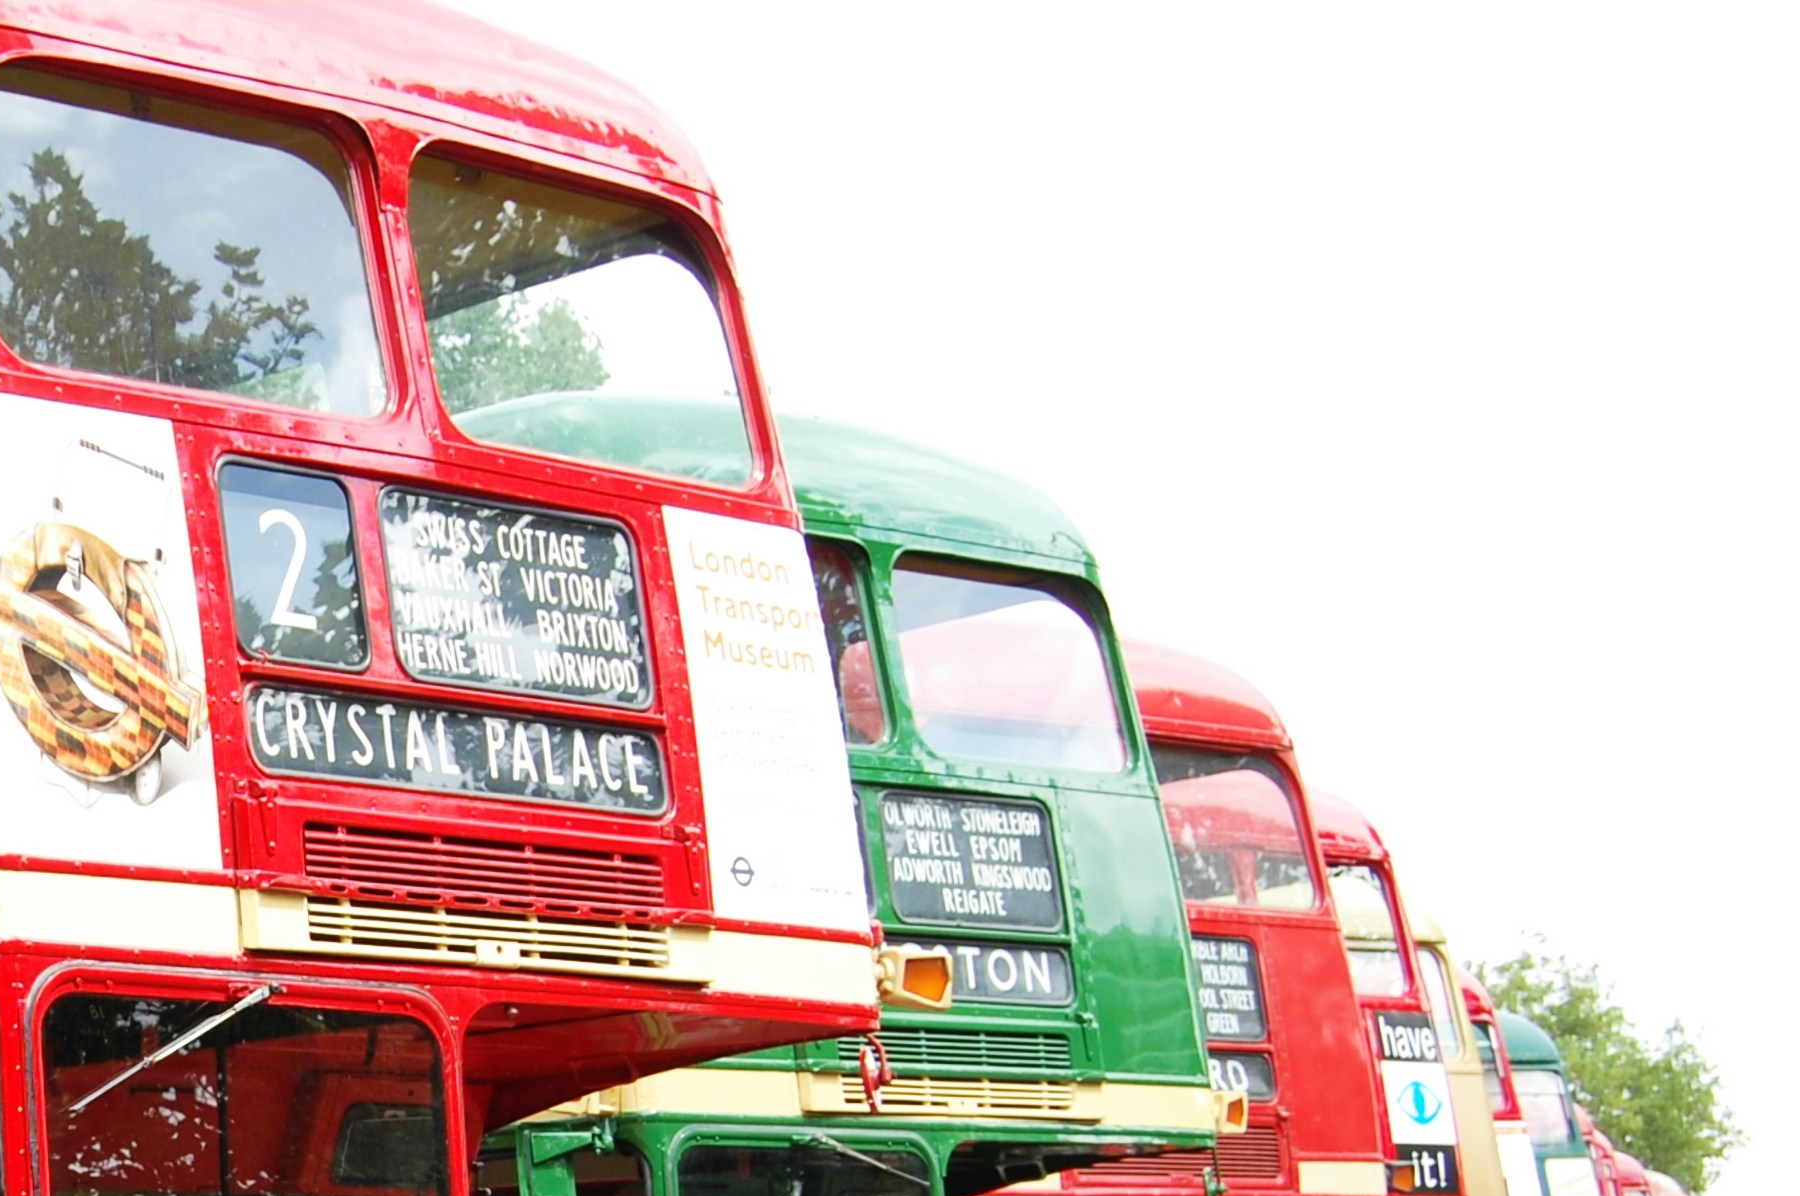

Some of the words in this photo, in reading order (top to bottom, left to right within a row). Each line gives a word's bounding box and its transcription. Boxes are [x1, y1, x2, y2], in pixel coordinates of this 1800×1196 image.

[412, 512, 485, 555] SWISS
[497, 525, 590, 570] COTTAGE
[688, 541, 789, 585] London
[258, 508, 317, 631] 2
[391, 549, 470, 593] BAKER
[477, 561, 502, 597] ST
[520, 567, 619, 615] VICTORIA
[396, 590, 513, 639] VAUXHALL
[536, 609, 629, 654] BRIXTON
[695, 584, 822, 635] Transport
[397, 632, 471, 675] HERNE
[475, 642, 522, 681] HILL
[533, 649, 640, 694] NORWOOD
[703, 629, 816, 674] Museum
[255, 689, 461, 777] CRYSTAL
[483, 716, 649, 796] PALACE
[883, 801, 953, 829] OLWORTH
[960, 808, 1041, 837] STONELEIGH
[906, 831, 960, 857] EWELL
[970, 836, 1023, 863] EPSOM
[889, 856, 965, 886] ADWORTH
[971, 862, 1053, 892] KINGSWOOD
[942, 888, 1008, 917] REIGATE
[1220, 989, 1256, 1011] STREET
[1378, 1015, 1436, 1060] have
[1412, 1151, 1447, 1188] it!
